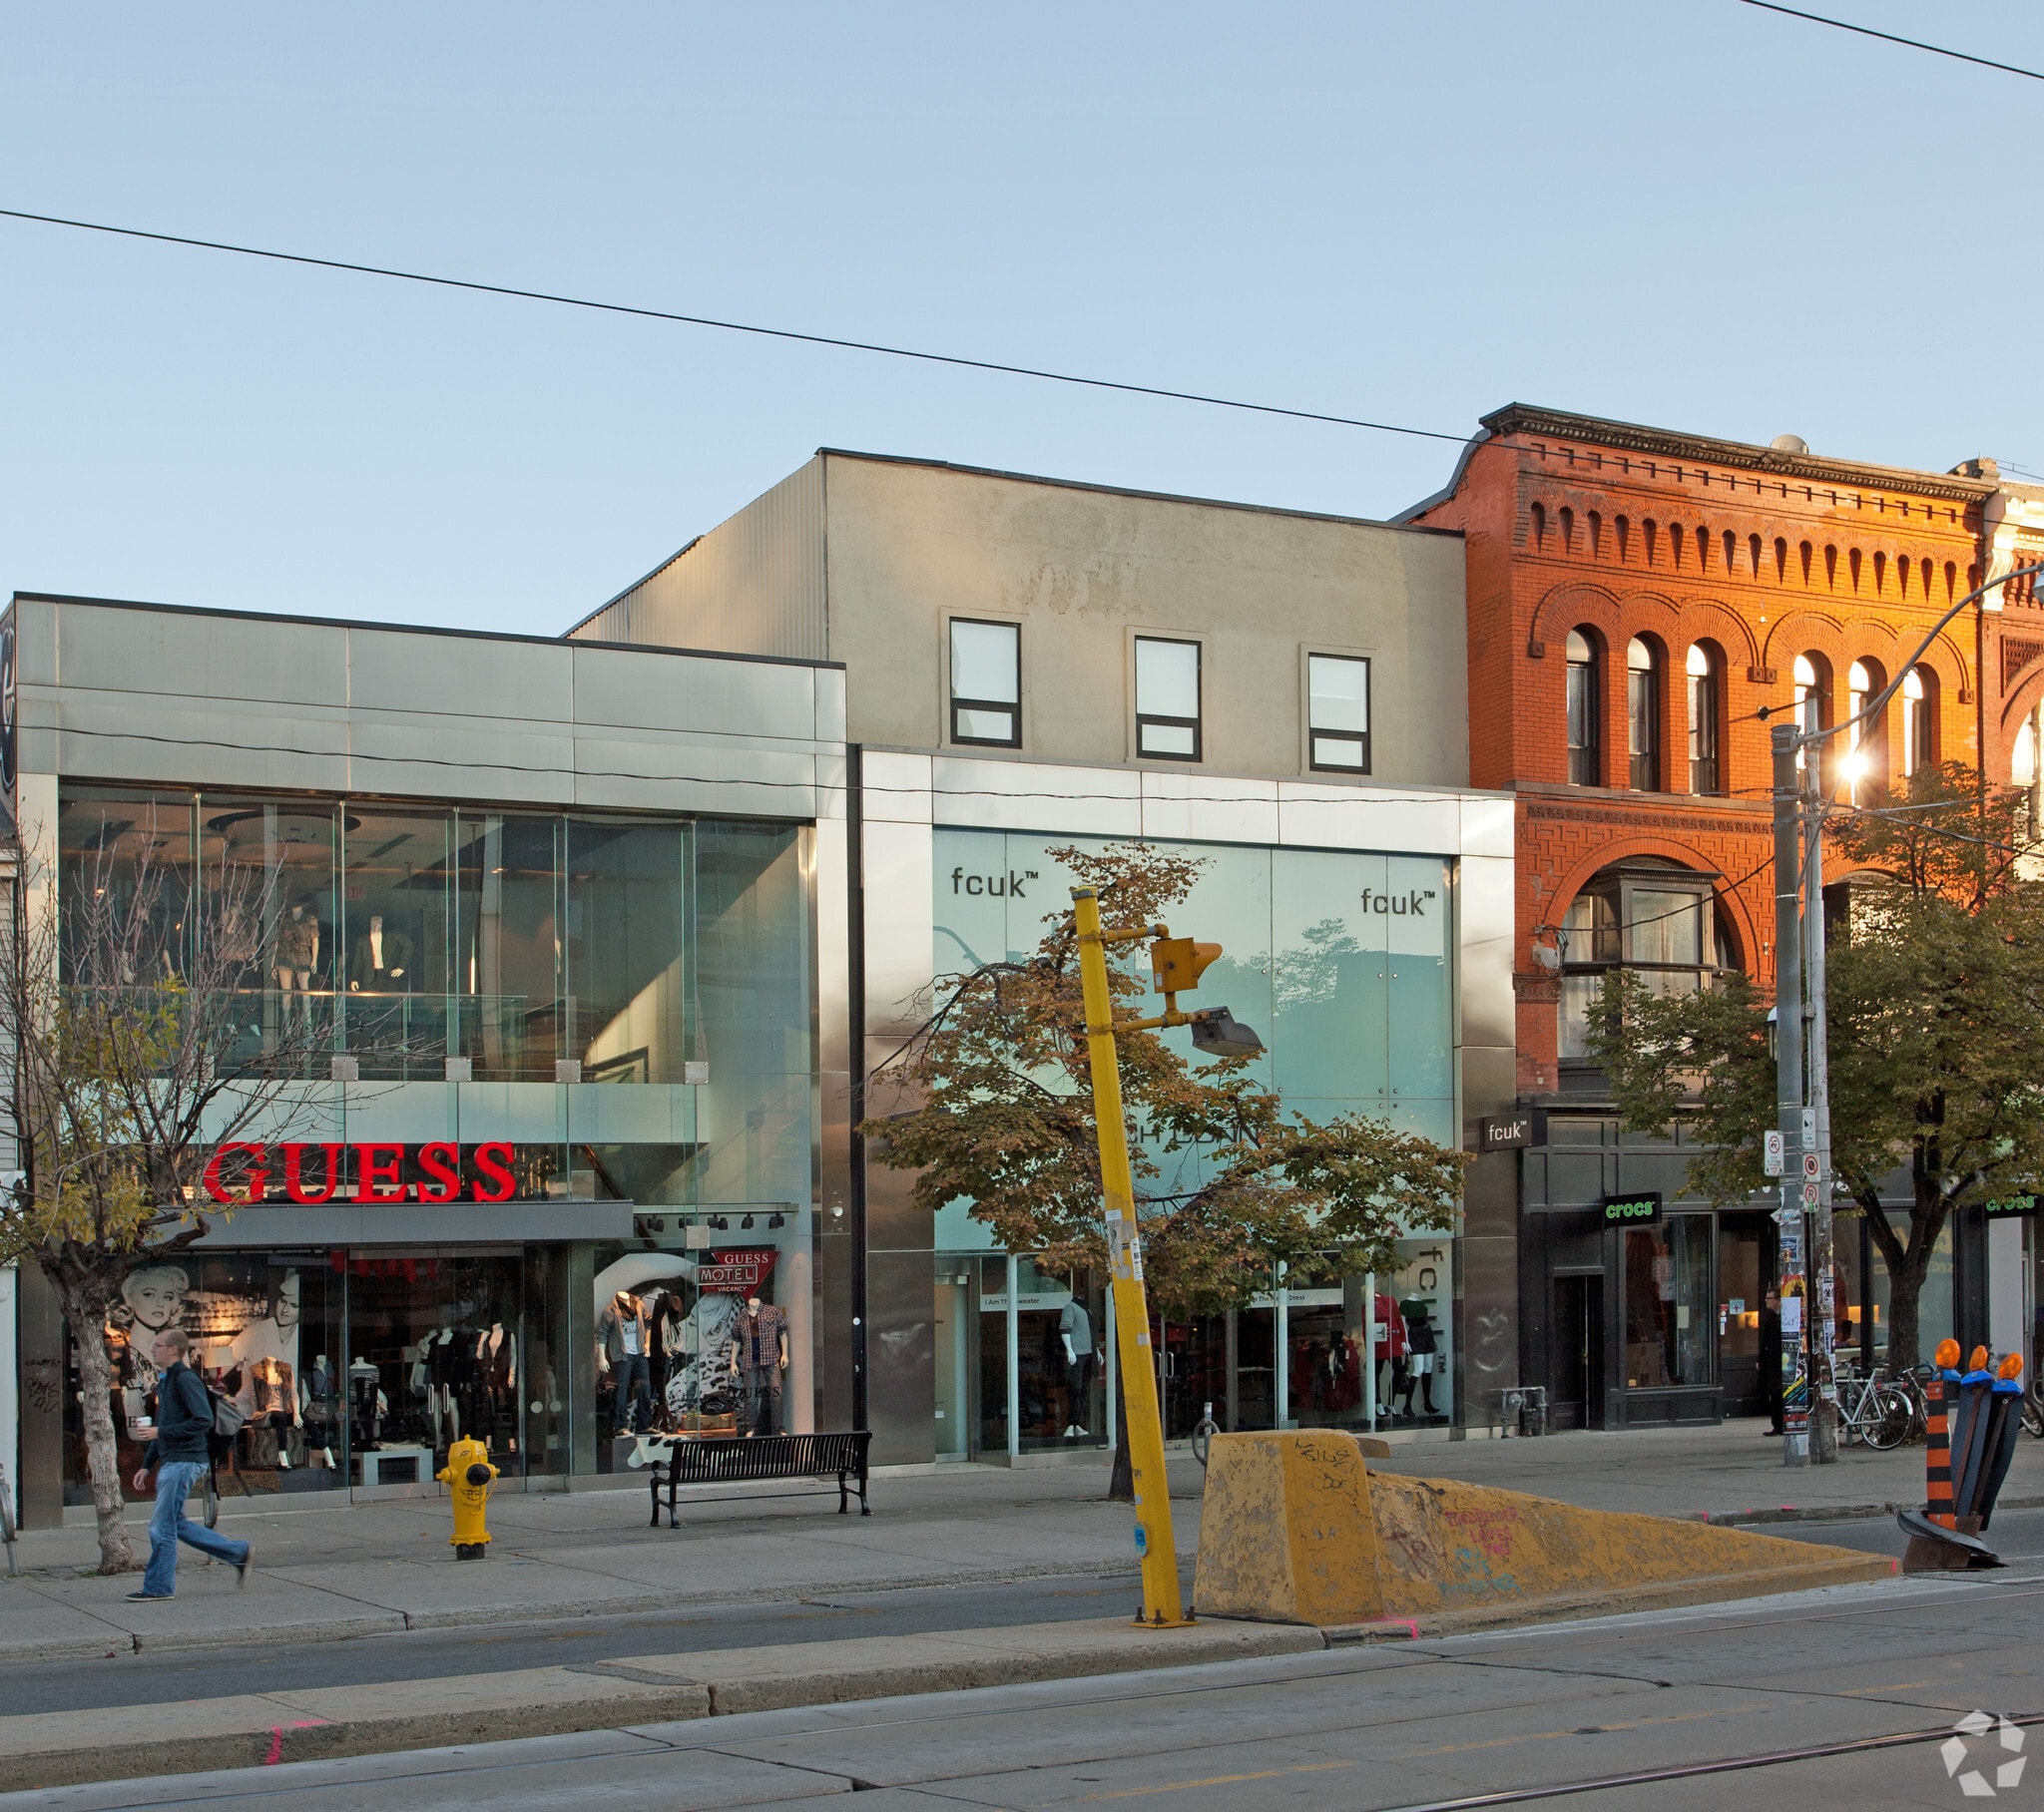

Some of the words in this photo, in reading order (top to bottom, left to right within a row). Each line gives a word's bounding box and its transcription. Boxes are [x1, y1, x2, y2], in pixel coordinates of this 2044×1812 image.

[203, 1140, 517, 1204] GUESS
[1605, 1200, 1654, 1219] crocs
[724, 1253, 769, 1264] GUESS
[700, 1267, 755, 1281] MOTEL
[737, 1386, 781, 1399] UESS
